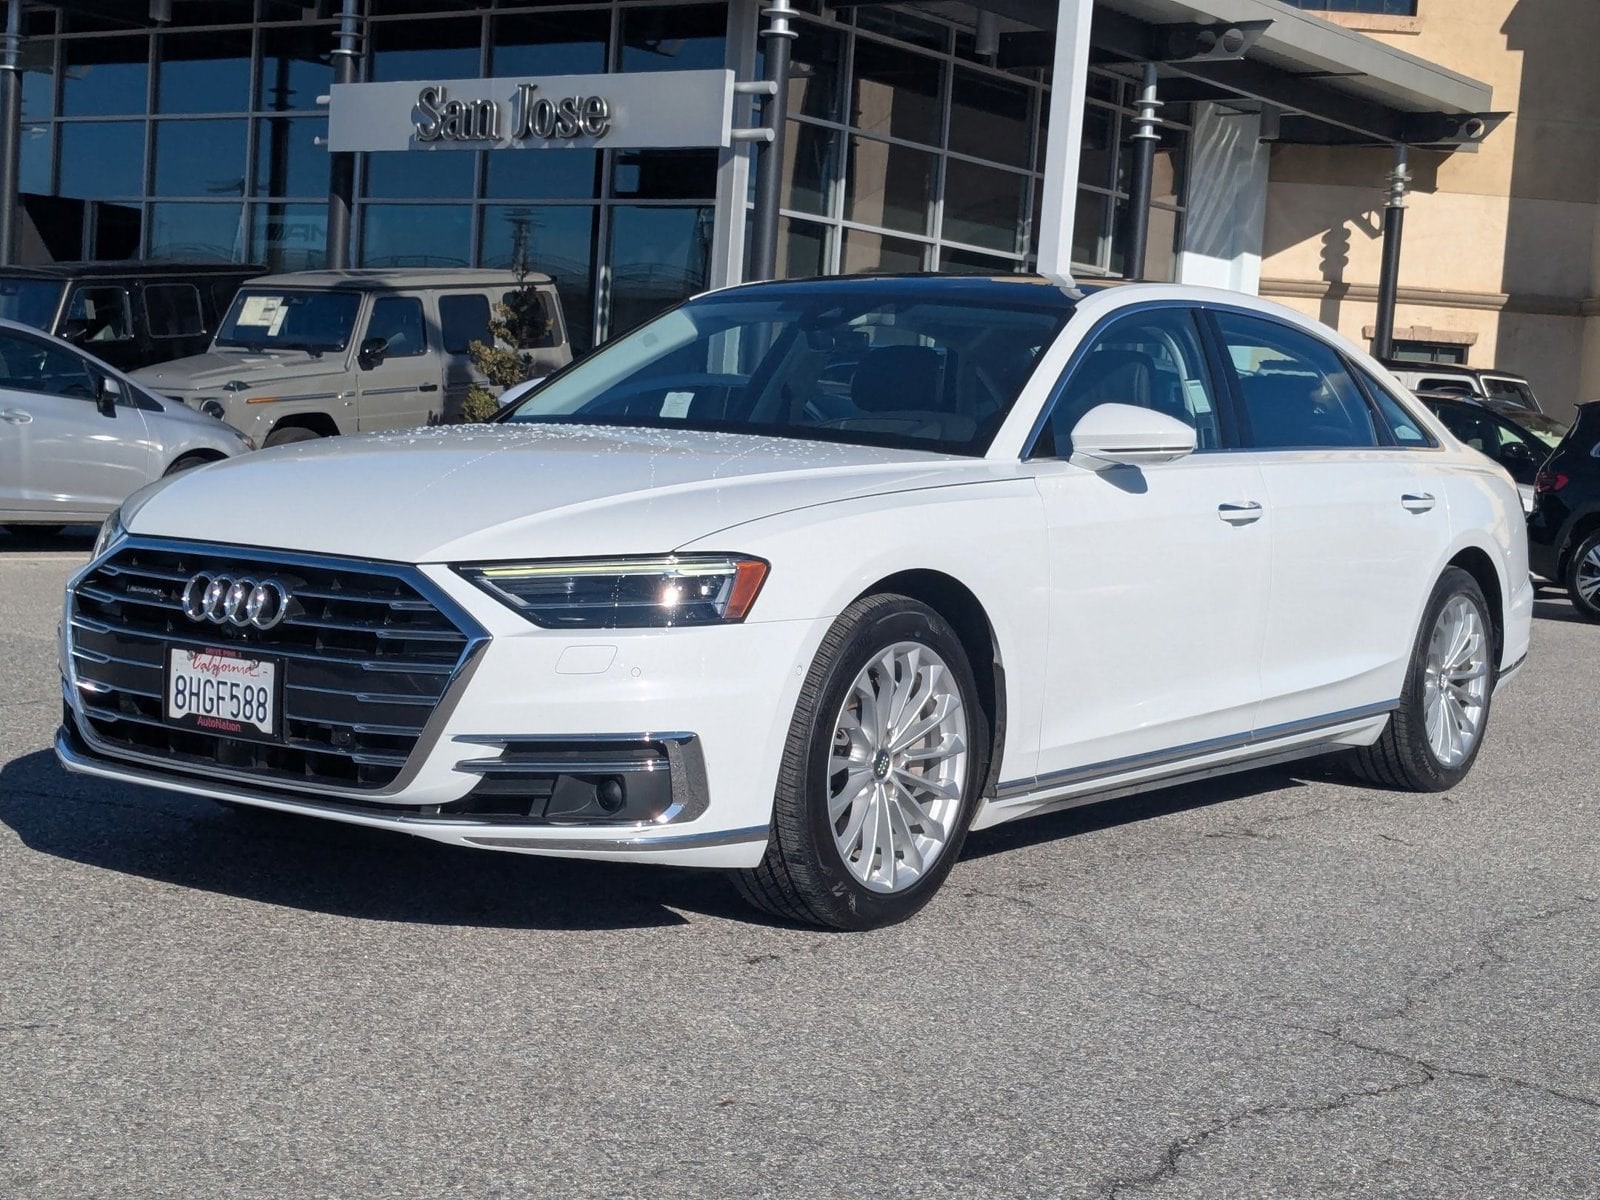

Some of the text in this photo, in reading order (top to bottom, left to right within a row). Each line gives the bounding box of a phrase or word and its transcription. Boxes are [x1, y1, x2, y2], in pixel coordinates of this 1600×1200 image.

[416, 83, 611, 141] San Jose
[193, 653, 259, 677] California
[174, 675, 268, 723] 8HGF588
[197, 716, 241, 733] AutoNation
